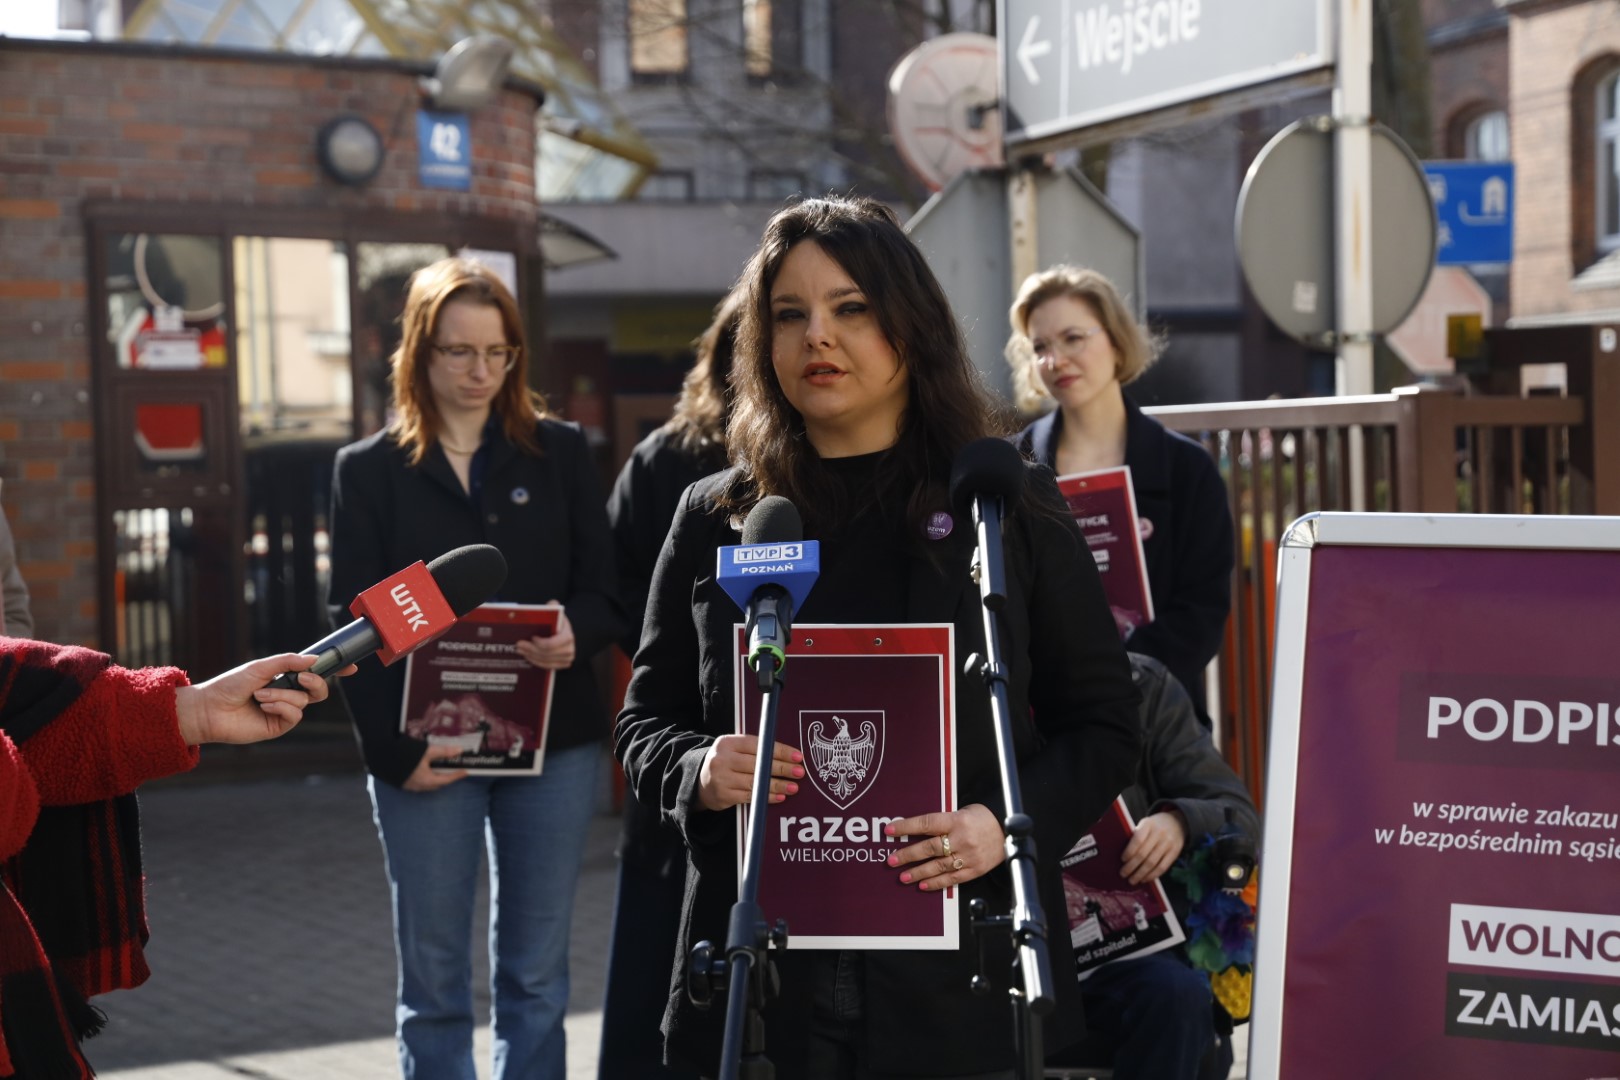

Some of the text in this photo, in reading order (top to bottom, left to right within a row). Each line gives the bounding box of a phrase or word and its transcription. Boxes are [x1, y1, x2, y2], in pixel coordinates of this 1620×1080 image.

[430, 122, 461, 161] 42
[741, 563, 794, 575] POZNAŃ
[390, 583, 429, 632] WTK
[1427, 696, 1620, 747] PODPI
[1413, 802, 1618, 829] w sprawie zakazu
[1375, 828, 1394, 844] w
[1399, 824, 1562, 856] bezpośrednim
[1461, 919, 1620, 963] WOLNO
[1457, 988, 1620, 1038] ZAMIA
